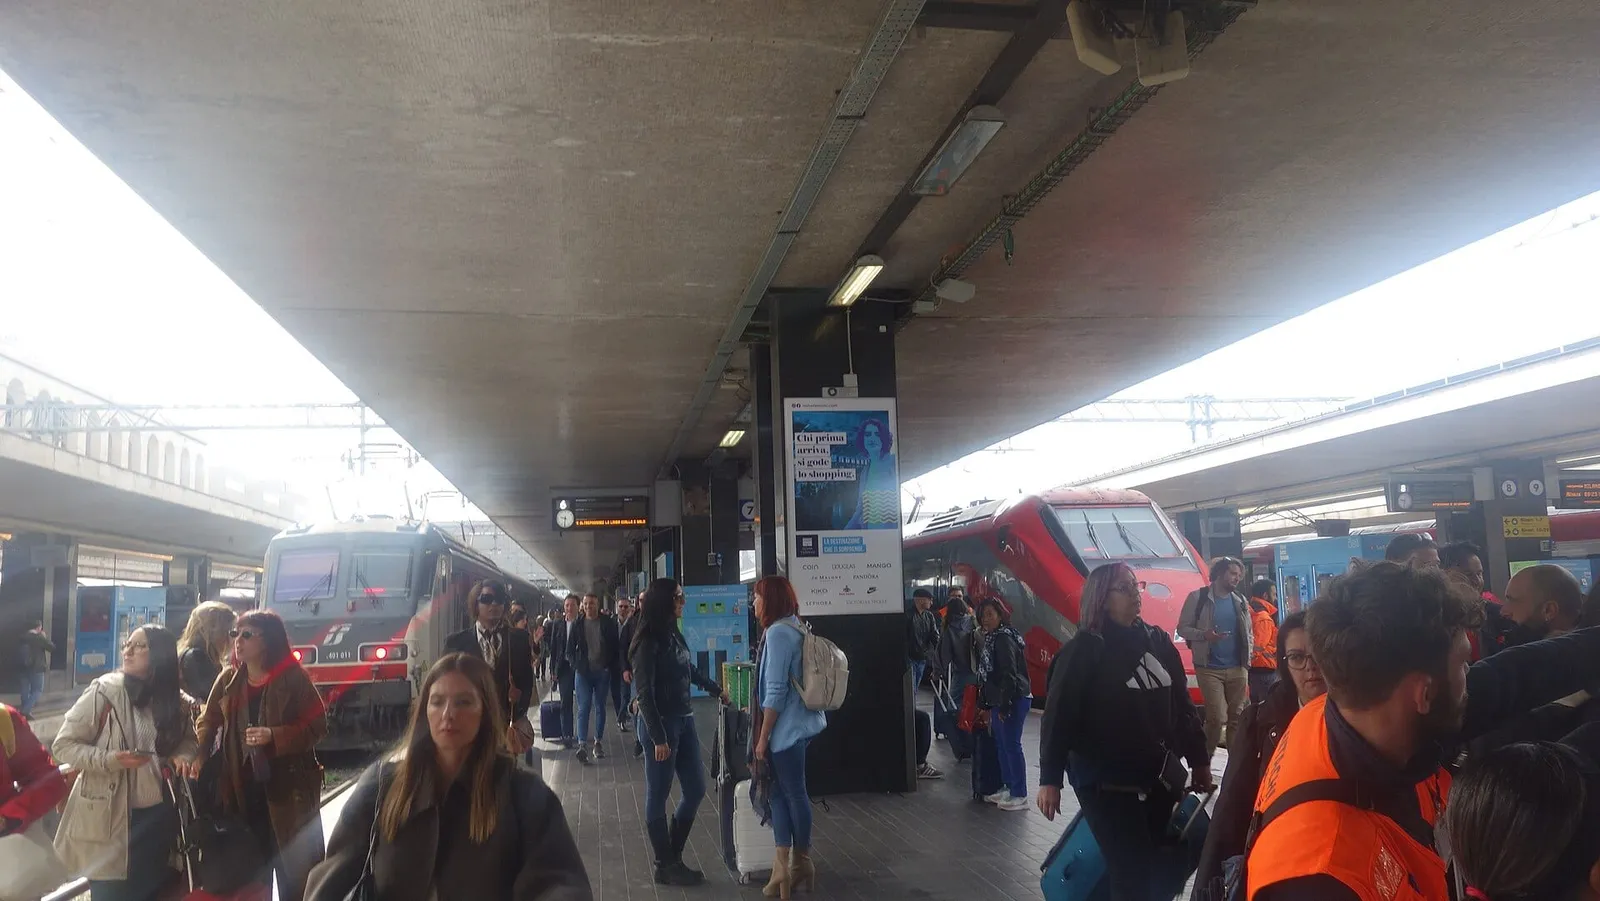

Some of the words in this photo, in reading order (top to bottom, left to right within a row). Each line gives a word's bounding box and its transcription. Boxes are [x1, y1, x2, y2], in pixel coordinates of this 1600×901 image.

[796, 433, 813, 442] Chi
[815, 433, 845, 444] prima
[797, 458, 806, 466] si
[807, 458, 829, 467] gode
[798, 470, 807, 478] lo
[1400, 484, 1406, 493] 8
[1506, 483, 1513, 492] 8
[1533, 483, 1539, 492] 9
[560, 499, 567, 510] 6
[747, 506, 754, 515] 7
